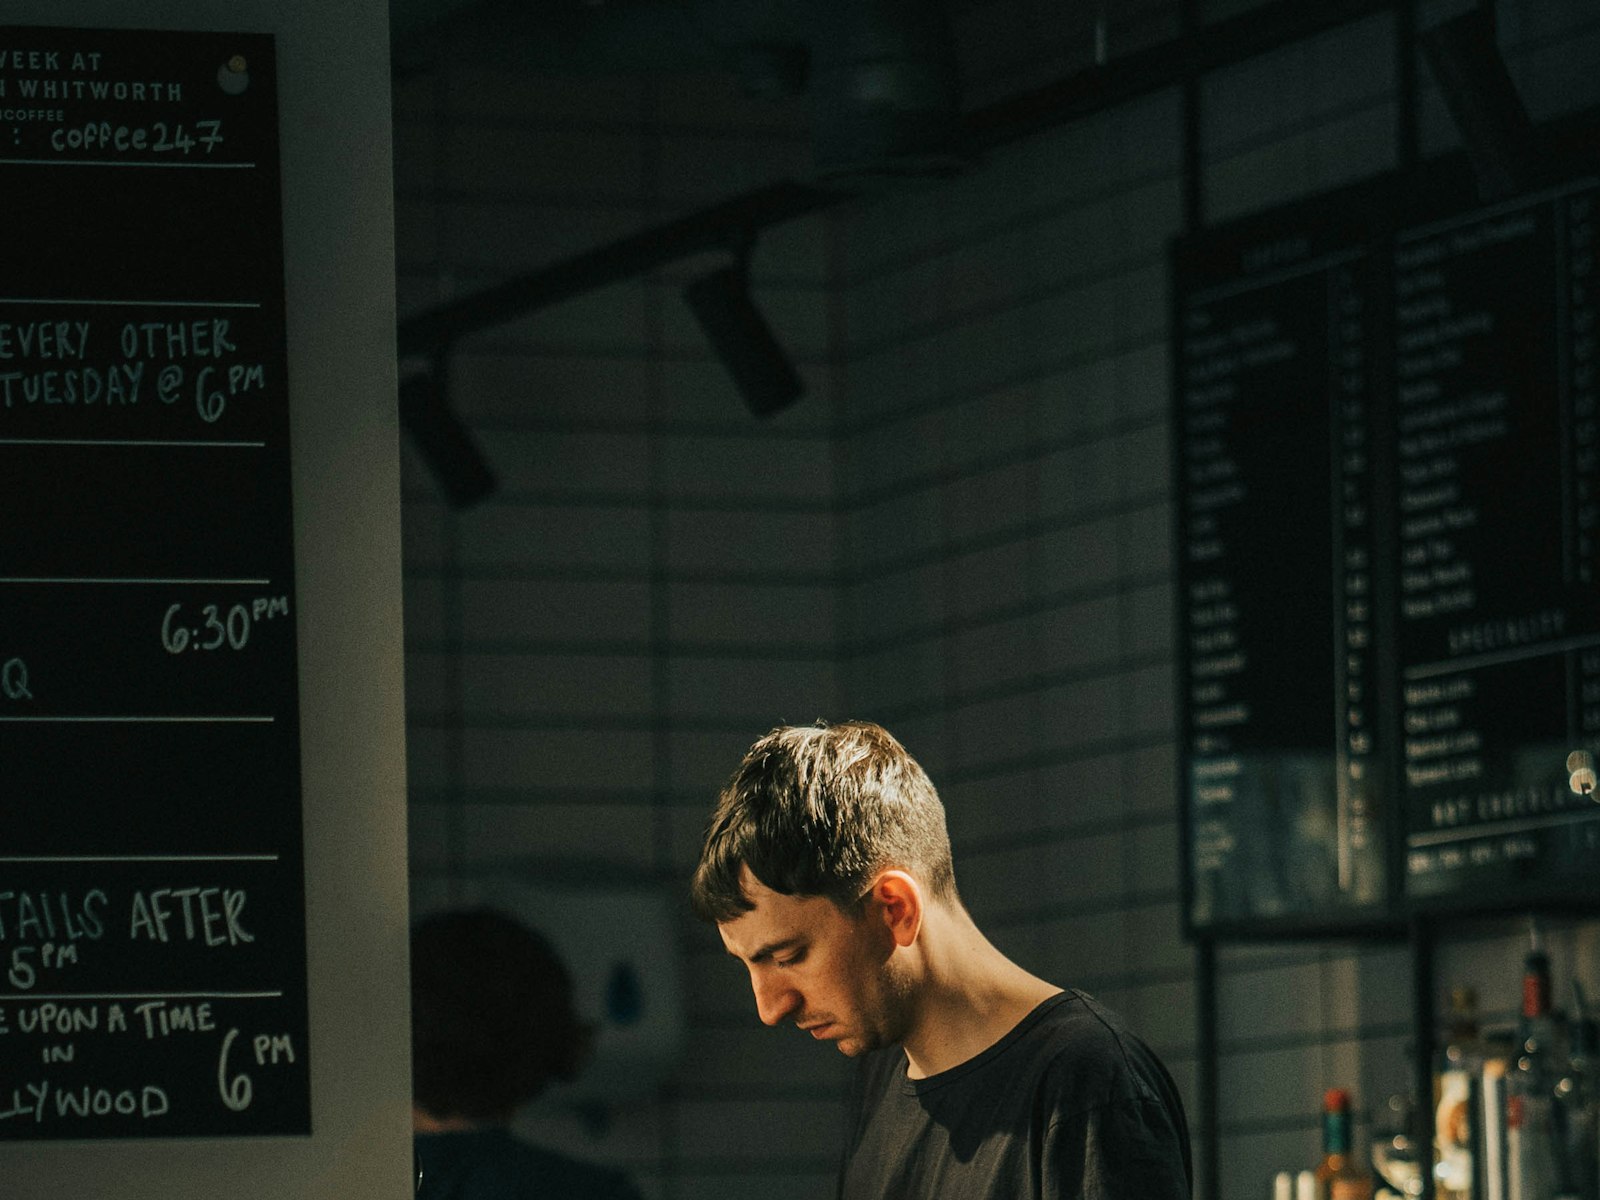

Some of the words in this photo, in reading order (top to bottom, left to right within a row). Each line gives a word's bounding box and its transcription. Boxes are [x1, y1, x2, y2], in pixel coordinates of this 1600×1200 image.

[72, 52, 101, 72] AT
[18, 79, 183, 102] WHITWORTH
[0, 109, 64, 122] COFFEE
[0, 321, 89, 360] EVERY
[121, 318, 237, 358] OTHER
[0, 360, 144, 408] TUESDAY
[157, 364, 184, 404] @
[2, 657, 33, 700] Q
[131, 887, 255, 946] AFTER
[18, 1003, 98, 1034] UPON
[108, 1004, 127, 1033] A
[134, 1001, 215, 1039] TIME
[42, 1044, 74, 1063] IN
[0, 1081, 168, 1123] LYWOOD
